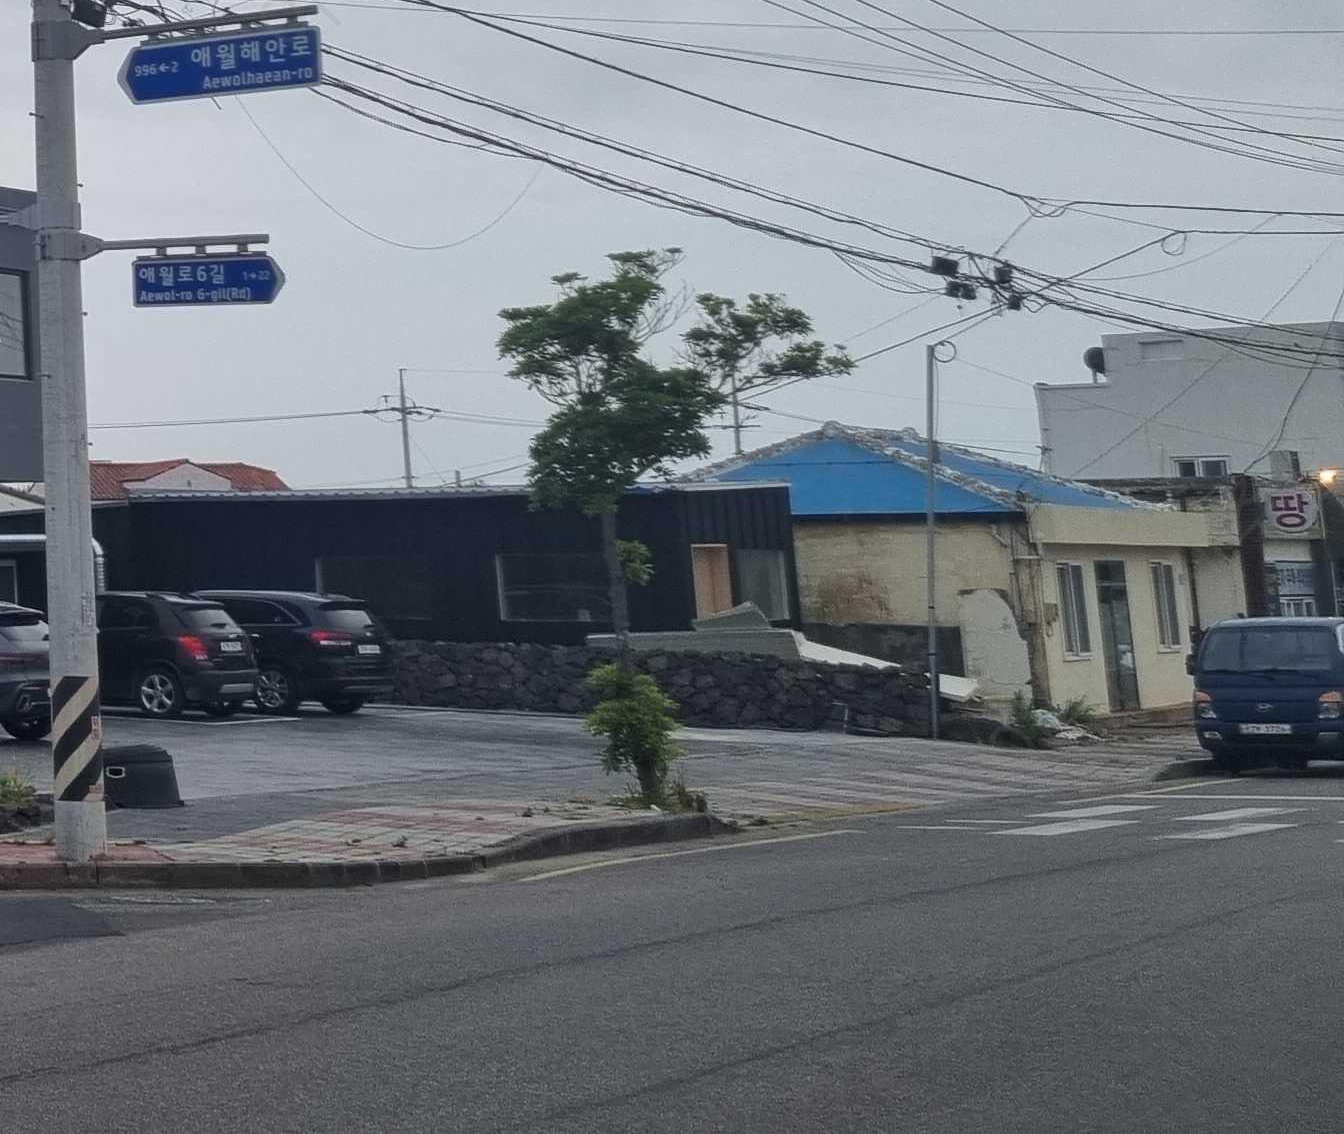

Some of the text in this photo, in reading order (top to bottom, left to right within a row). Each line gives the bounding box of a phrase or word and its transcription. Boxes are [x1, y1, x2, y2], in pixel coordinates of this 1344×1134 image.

[190, 35, 312, 70] 애월해안로
[202, 67, 312, 89] Aewolhaean-ro
[138, 264, 225, 286] 애월로6길
[139, 289, 193, 301] Aewol-ro
[1270, 493, 1309, 529] 땅
